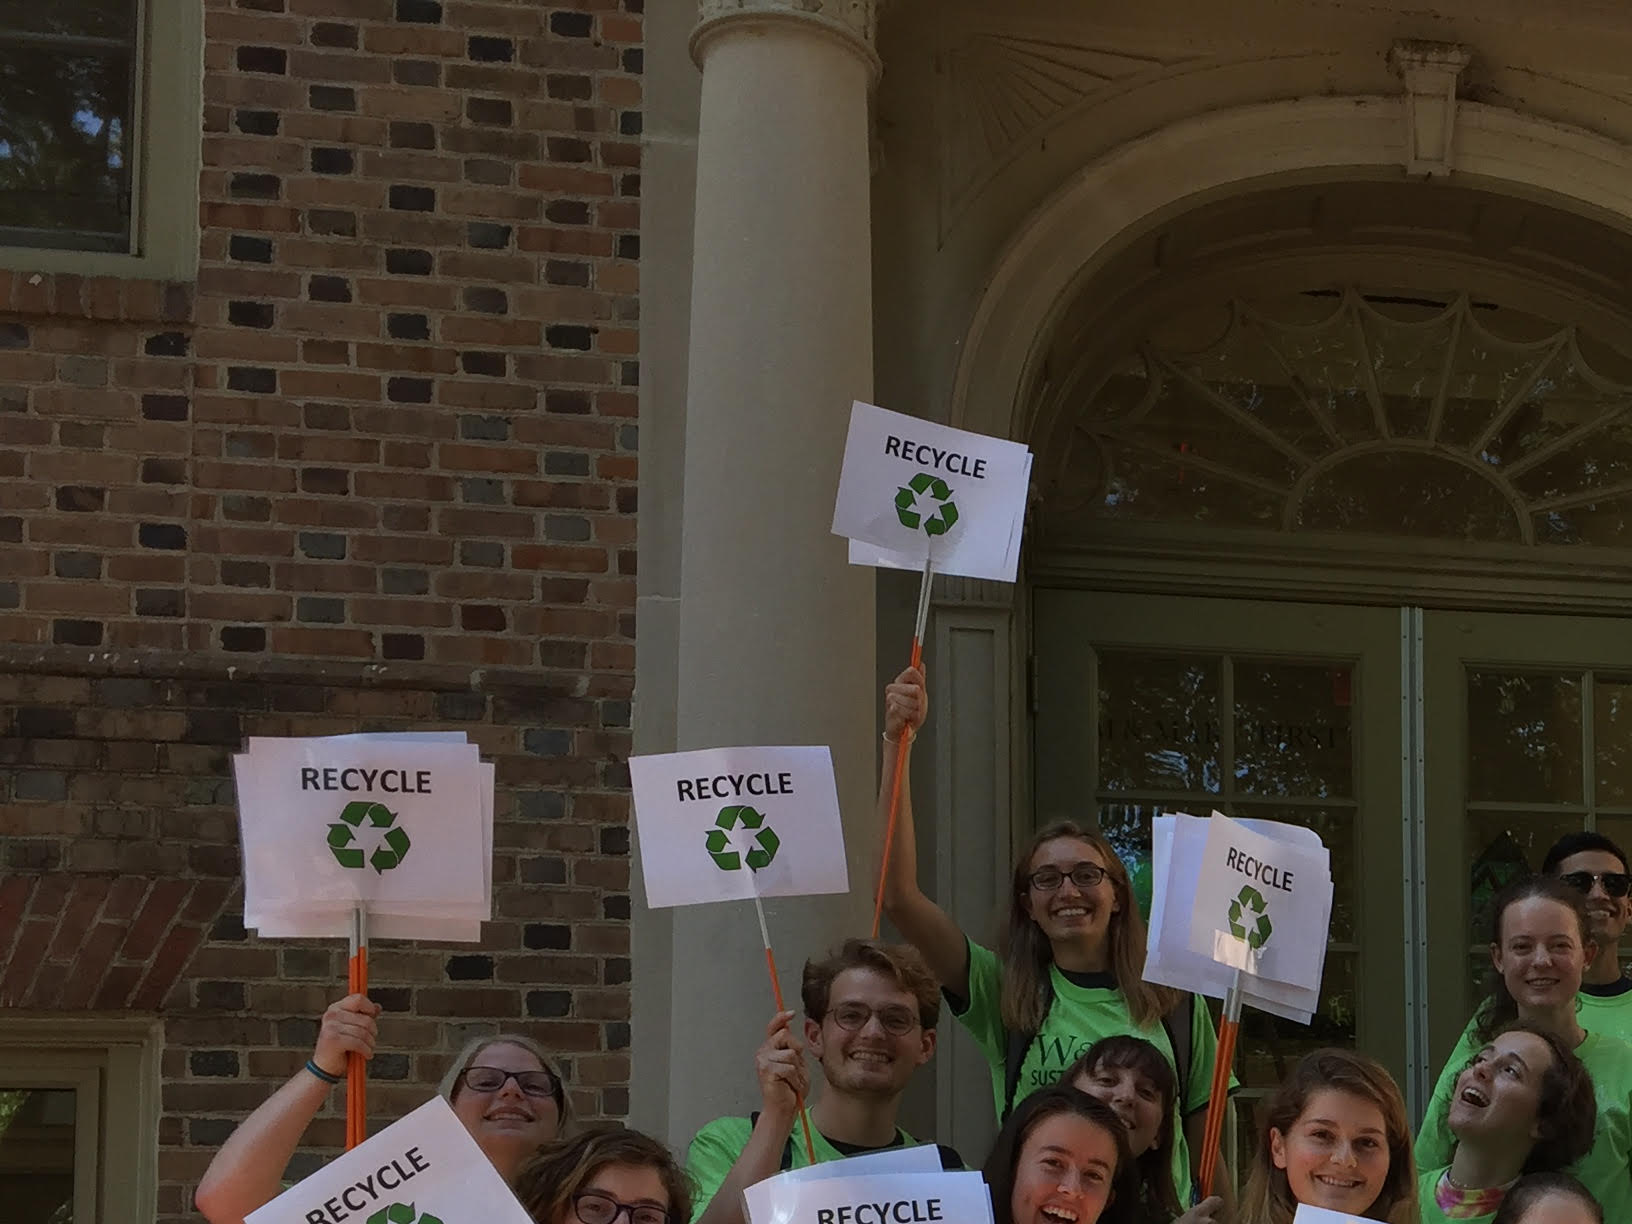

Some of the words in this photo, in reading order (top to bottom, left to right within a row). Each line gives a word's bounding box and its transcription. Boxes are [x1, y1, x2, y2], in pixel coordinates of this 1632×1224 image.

[884, 435, 987, 479] RECYCLE
[301, 767, 432, 794] RECYCLE
[677, 772, 794, 802] RECYCLE
[1226, 846, 1294, 893] RECYCLE
